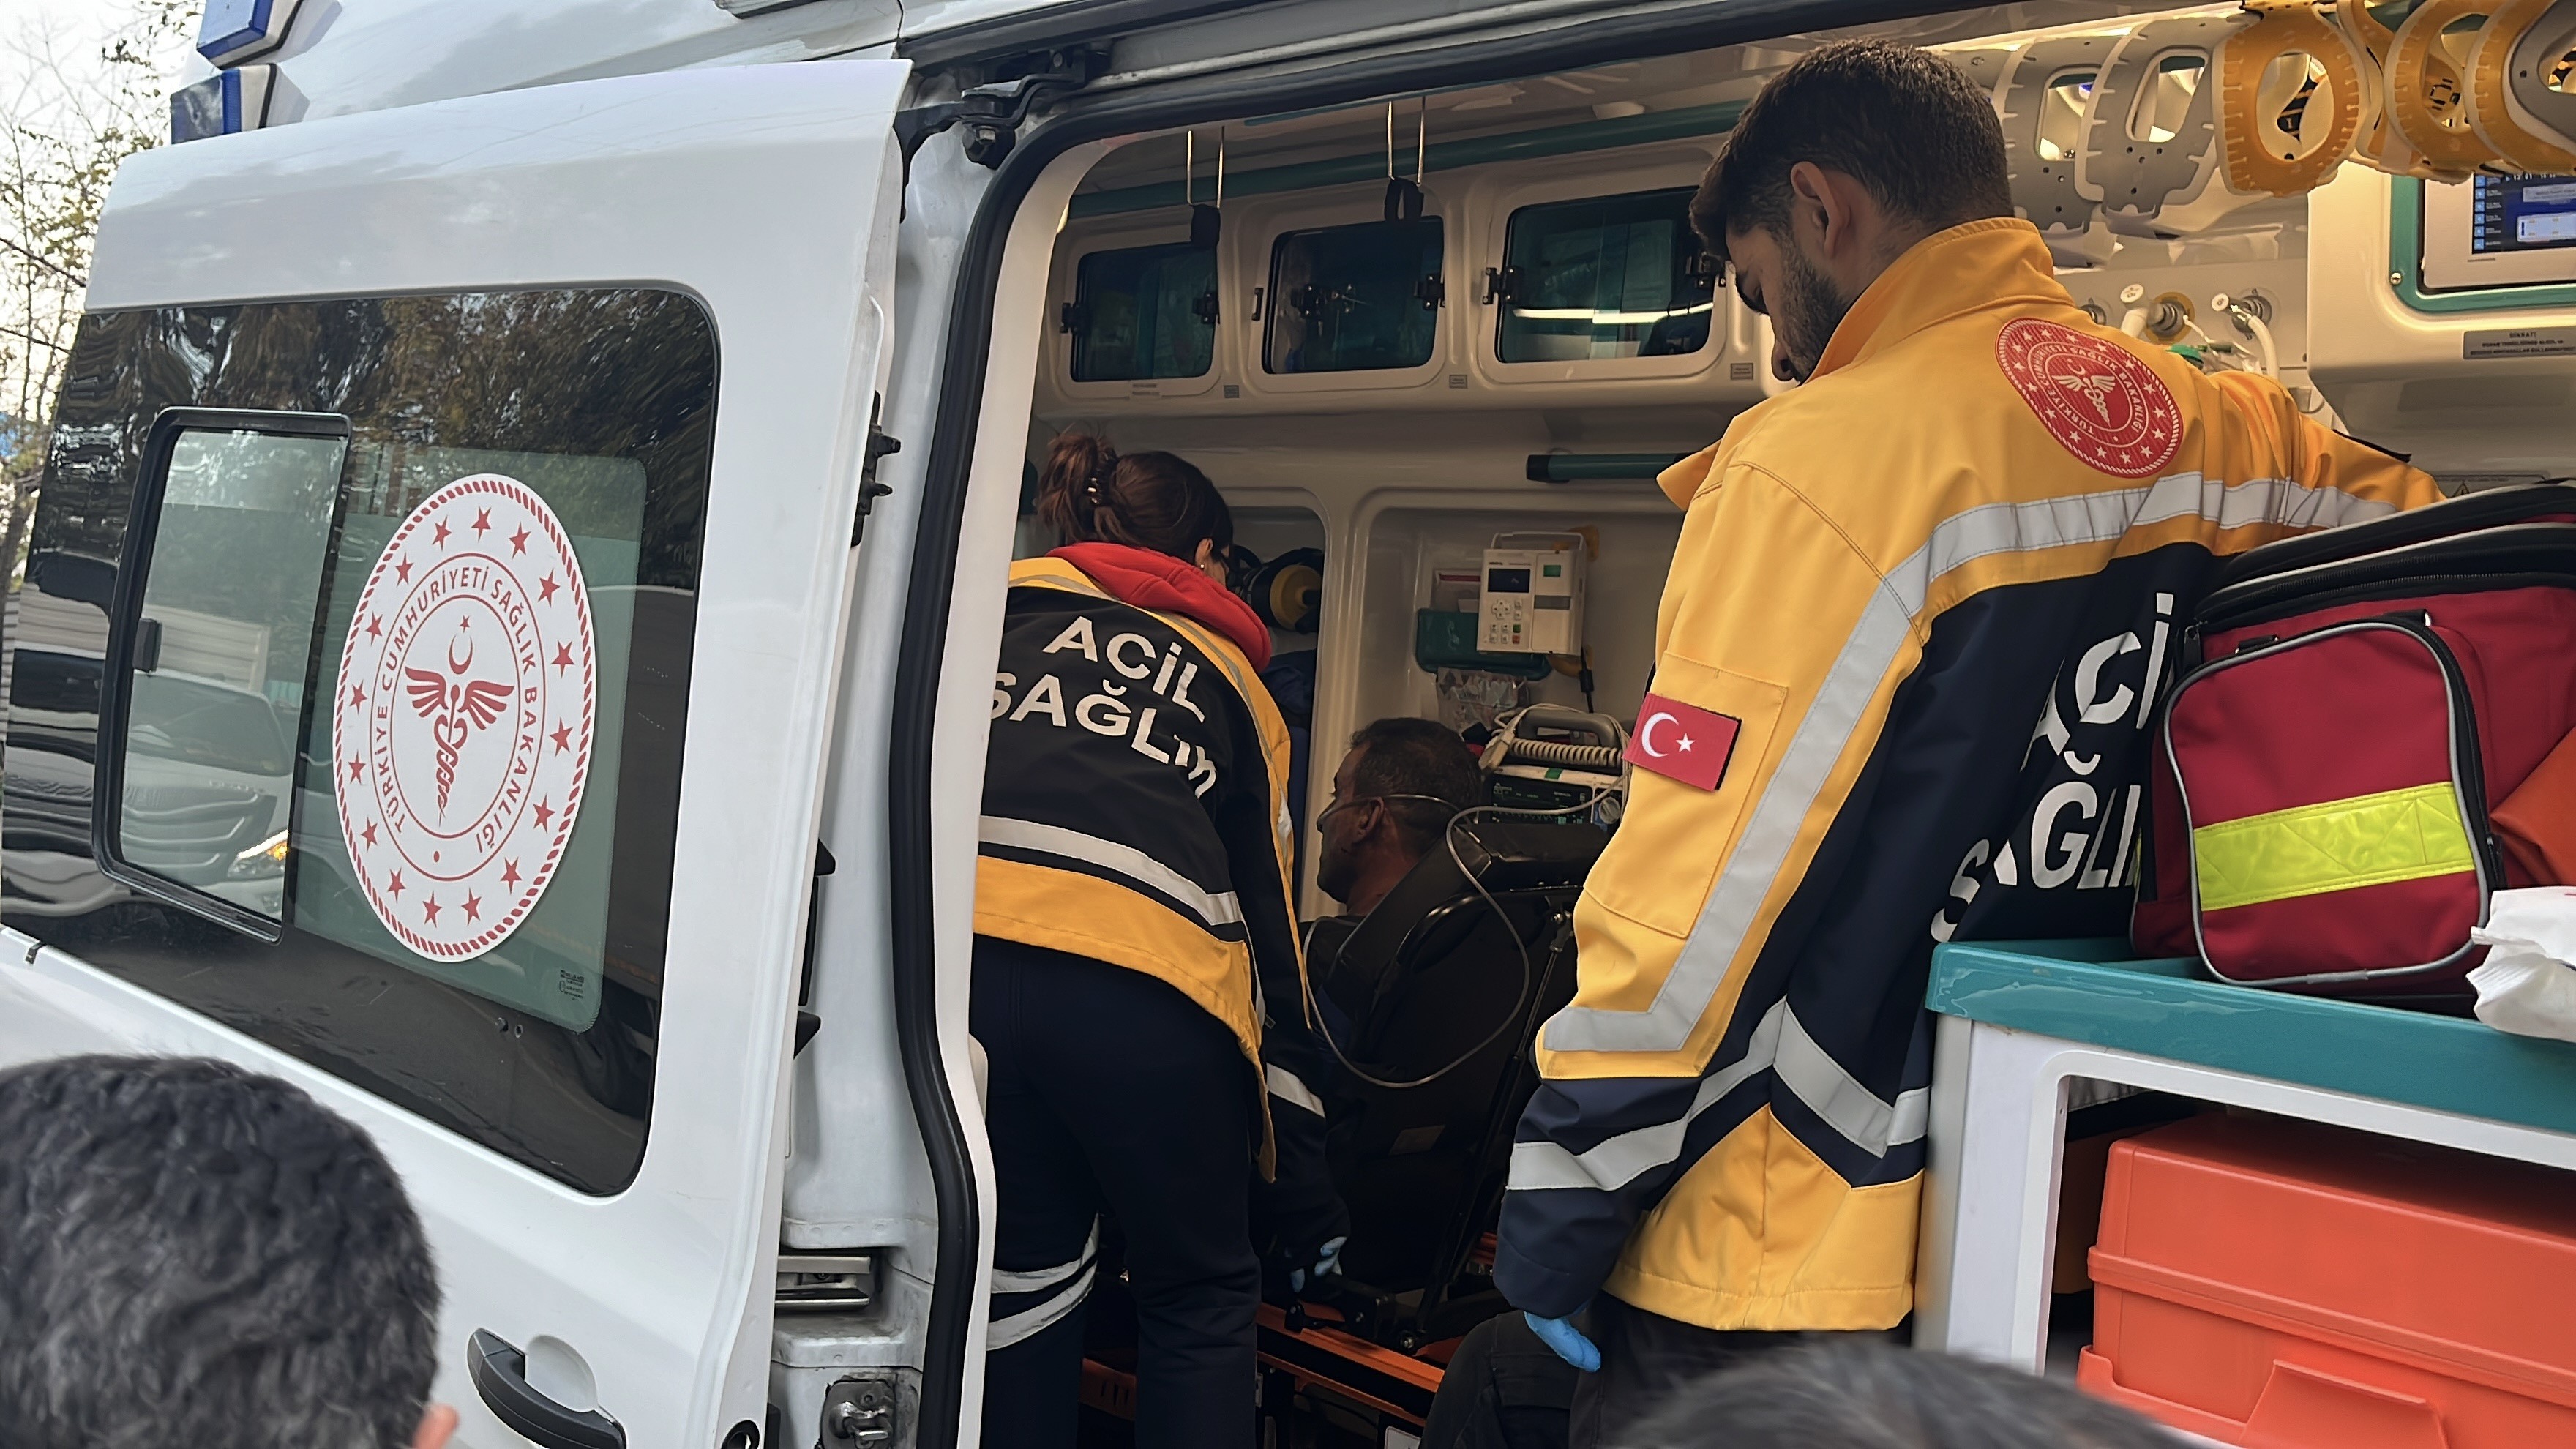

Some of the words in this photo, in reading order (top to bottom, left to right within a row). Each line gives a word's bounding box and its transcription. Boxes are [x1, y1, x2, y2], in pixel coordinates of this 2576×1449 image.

[381, 565, 490, 692] CUMHURİYETİ
[490, 578, 536, 675] SAĞLIK
[1041, 615, 1206, 723] ACİL
[2020, 592, 2175, 772] ACİ
[374, 705, 405, 834] TÜRKİYE
[475, 686, 538, 854] BAKANLIĞI
